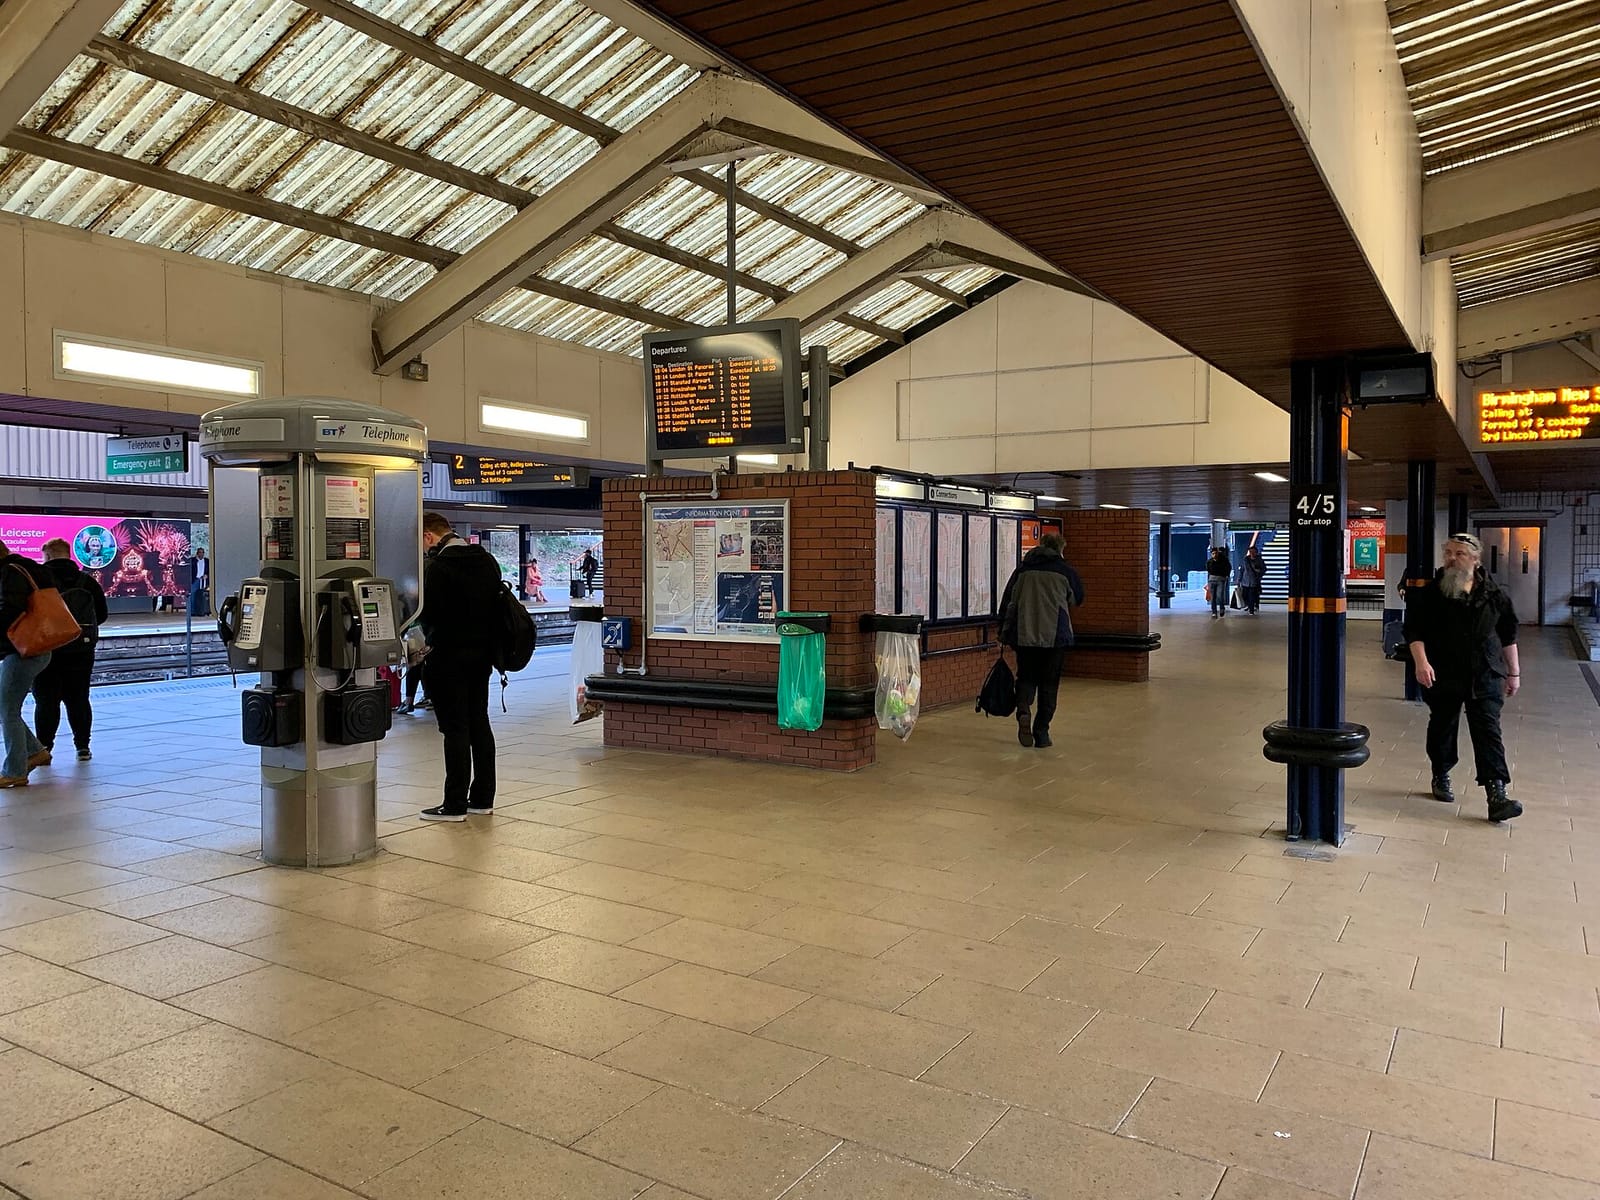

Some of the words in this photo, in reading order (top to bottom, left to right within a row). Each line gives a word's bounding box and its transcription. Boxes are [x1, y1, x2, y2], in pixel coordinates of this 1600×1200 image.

[652, 346, 688, 356] Departures
[1482, 390, 1556, 406] Birmingham
[1561, 388, 1590, 404] New
[1482, 408, 1515, 419] Calling
[1518, 406, 1534, 417] at:
[1482, 419, 1518, 431] Formed
[1521, 418, 1534, 429] of
[1536, 417, 1545, 428] 2
[1547, 416, 1590, 428] coaches
[322, 428, 338, 436] BT
[362, 425, 410, 442] Telephone
[1482, 431, 1500, 442] 3rd
[1502, 430, 1538, 440] Lincoln
[1541, 427, 1582, 439] Central
[128, 440, 160, 450] Telephone
[112, 460, 148, 470] Emergency
[148, 458, 161, 467] exit
[456, 455, 464, 469] 2
[1296, 493, 1335, 516] 4/5
[1314, 518, 1332, 526] stop
[1348, 520, 1384, 530] Slimming
[0, 528, 46, 538] Leicester
